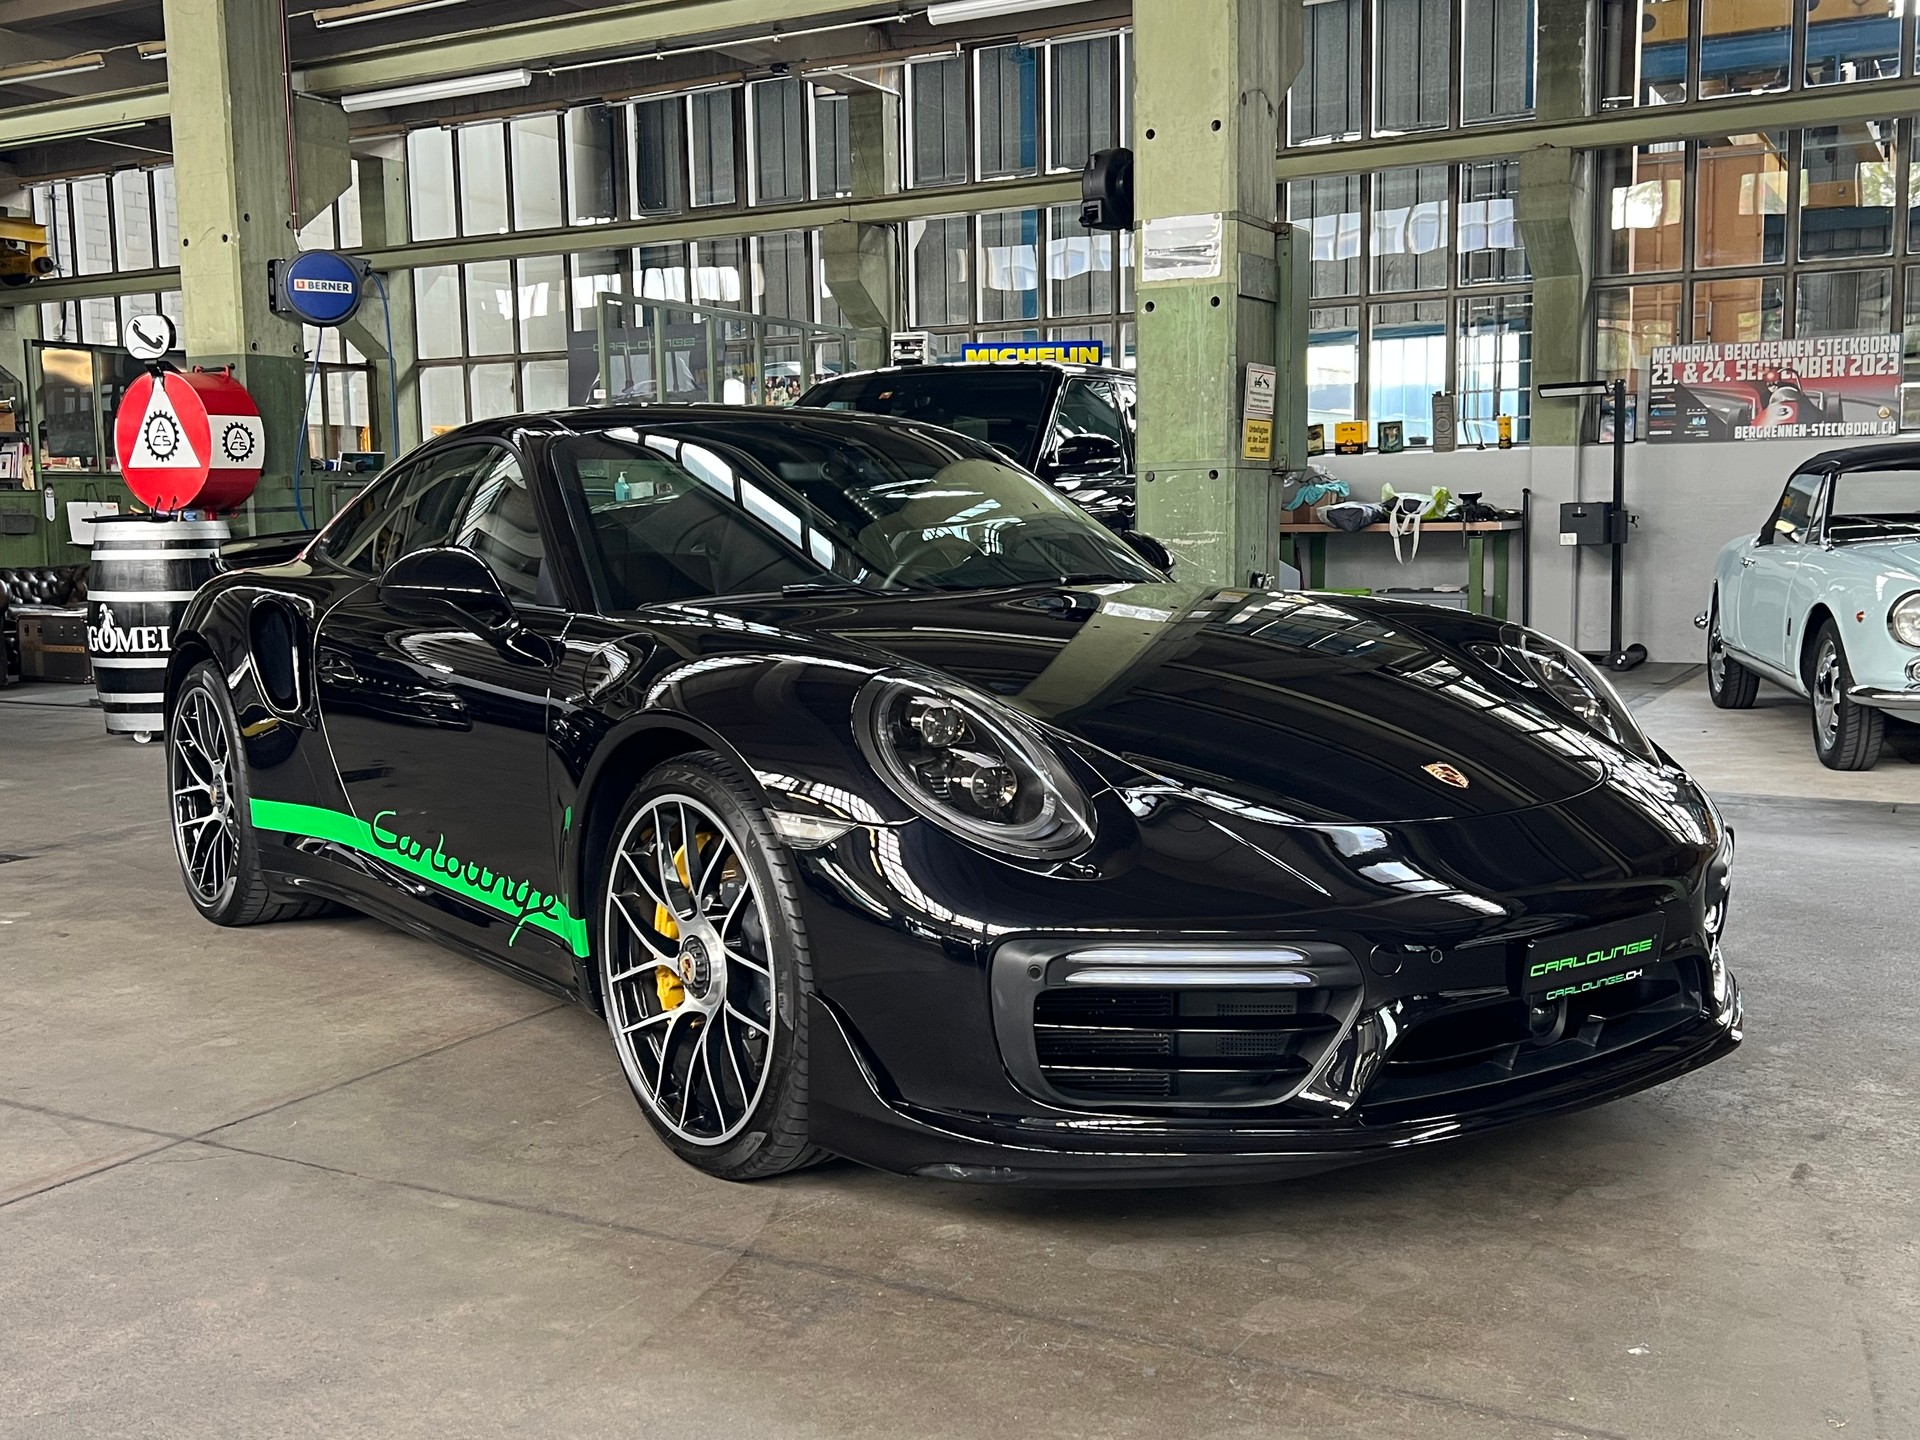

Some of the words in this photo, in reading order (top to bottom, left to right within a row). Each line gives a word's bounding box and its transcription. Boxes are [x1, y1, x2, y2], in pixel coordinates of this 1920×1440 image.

[308, 281, 349, 291] BERNER
[965, 346, 1099, 363] MICHELIN
[1652, 345, 1722, 365] MEMORIAL
[1724, 340, 1814, 361] BERGRENNEN
[1817, 334, 1900, 356] STECKBORN
[1651, 363, 1679, 385] 23.
[1683, 363, 1698, 384] &
[1702, 361, 1731, 383] 24.
[1849, 353, 1899, 377] 2023
[1734, 421, 1896, 439] BERGRENNEN-STECKBORN.CH
[1530, 938, 1653, 977] CARLOUNGE
[1546, 968, 1643, 1000] CARLOUNGE.CH
